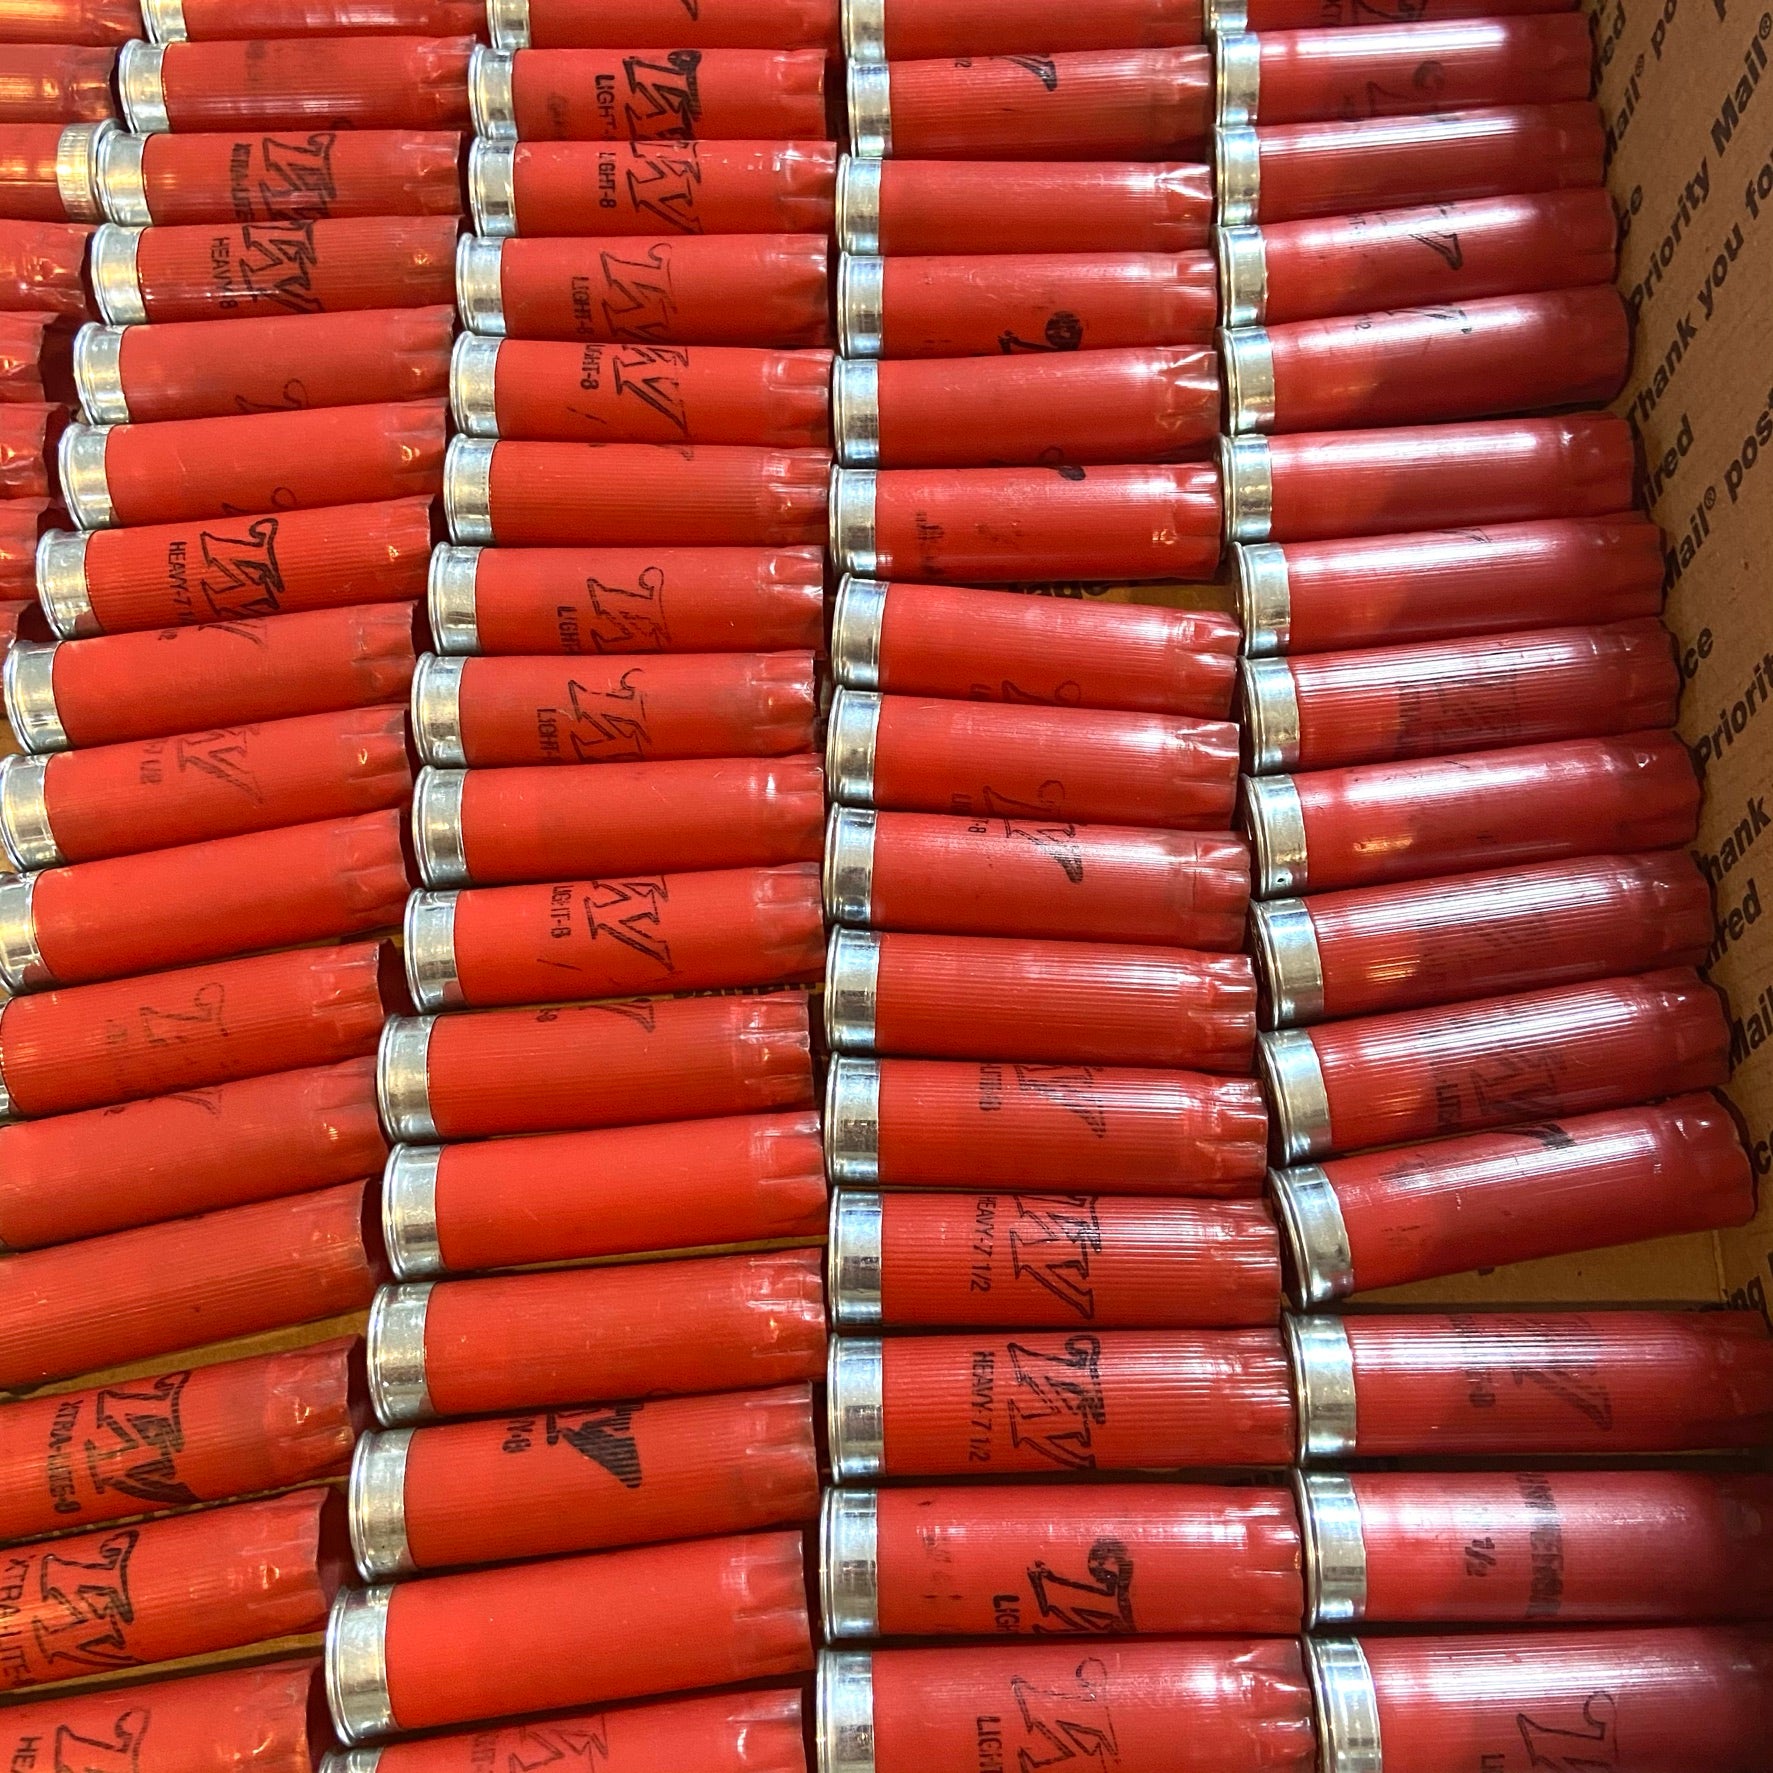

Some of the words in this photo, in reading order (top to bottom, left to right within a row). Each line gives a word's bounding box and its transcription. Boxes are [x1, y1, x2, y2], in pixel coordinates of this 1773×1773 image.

[594, 74, 617, 141] LIGHT-
[1697, 222, 1744, 321] you
[1745, 148, 1773, 220] fo
[1697, 797, 1771, 885] hank
[970, 1263, 995, 1292] 1/2
